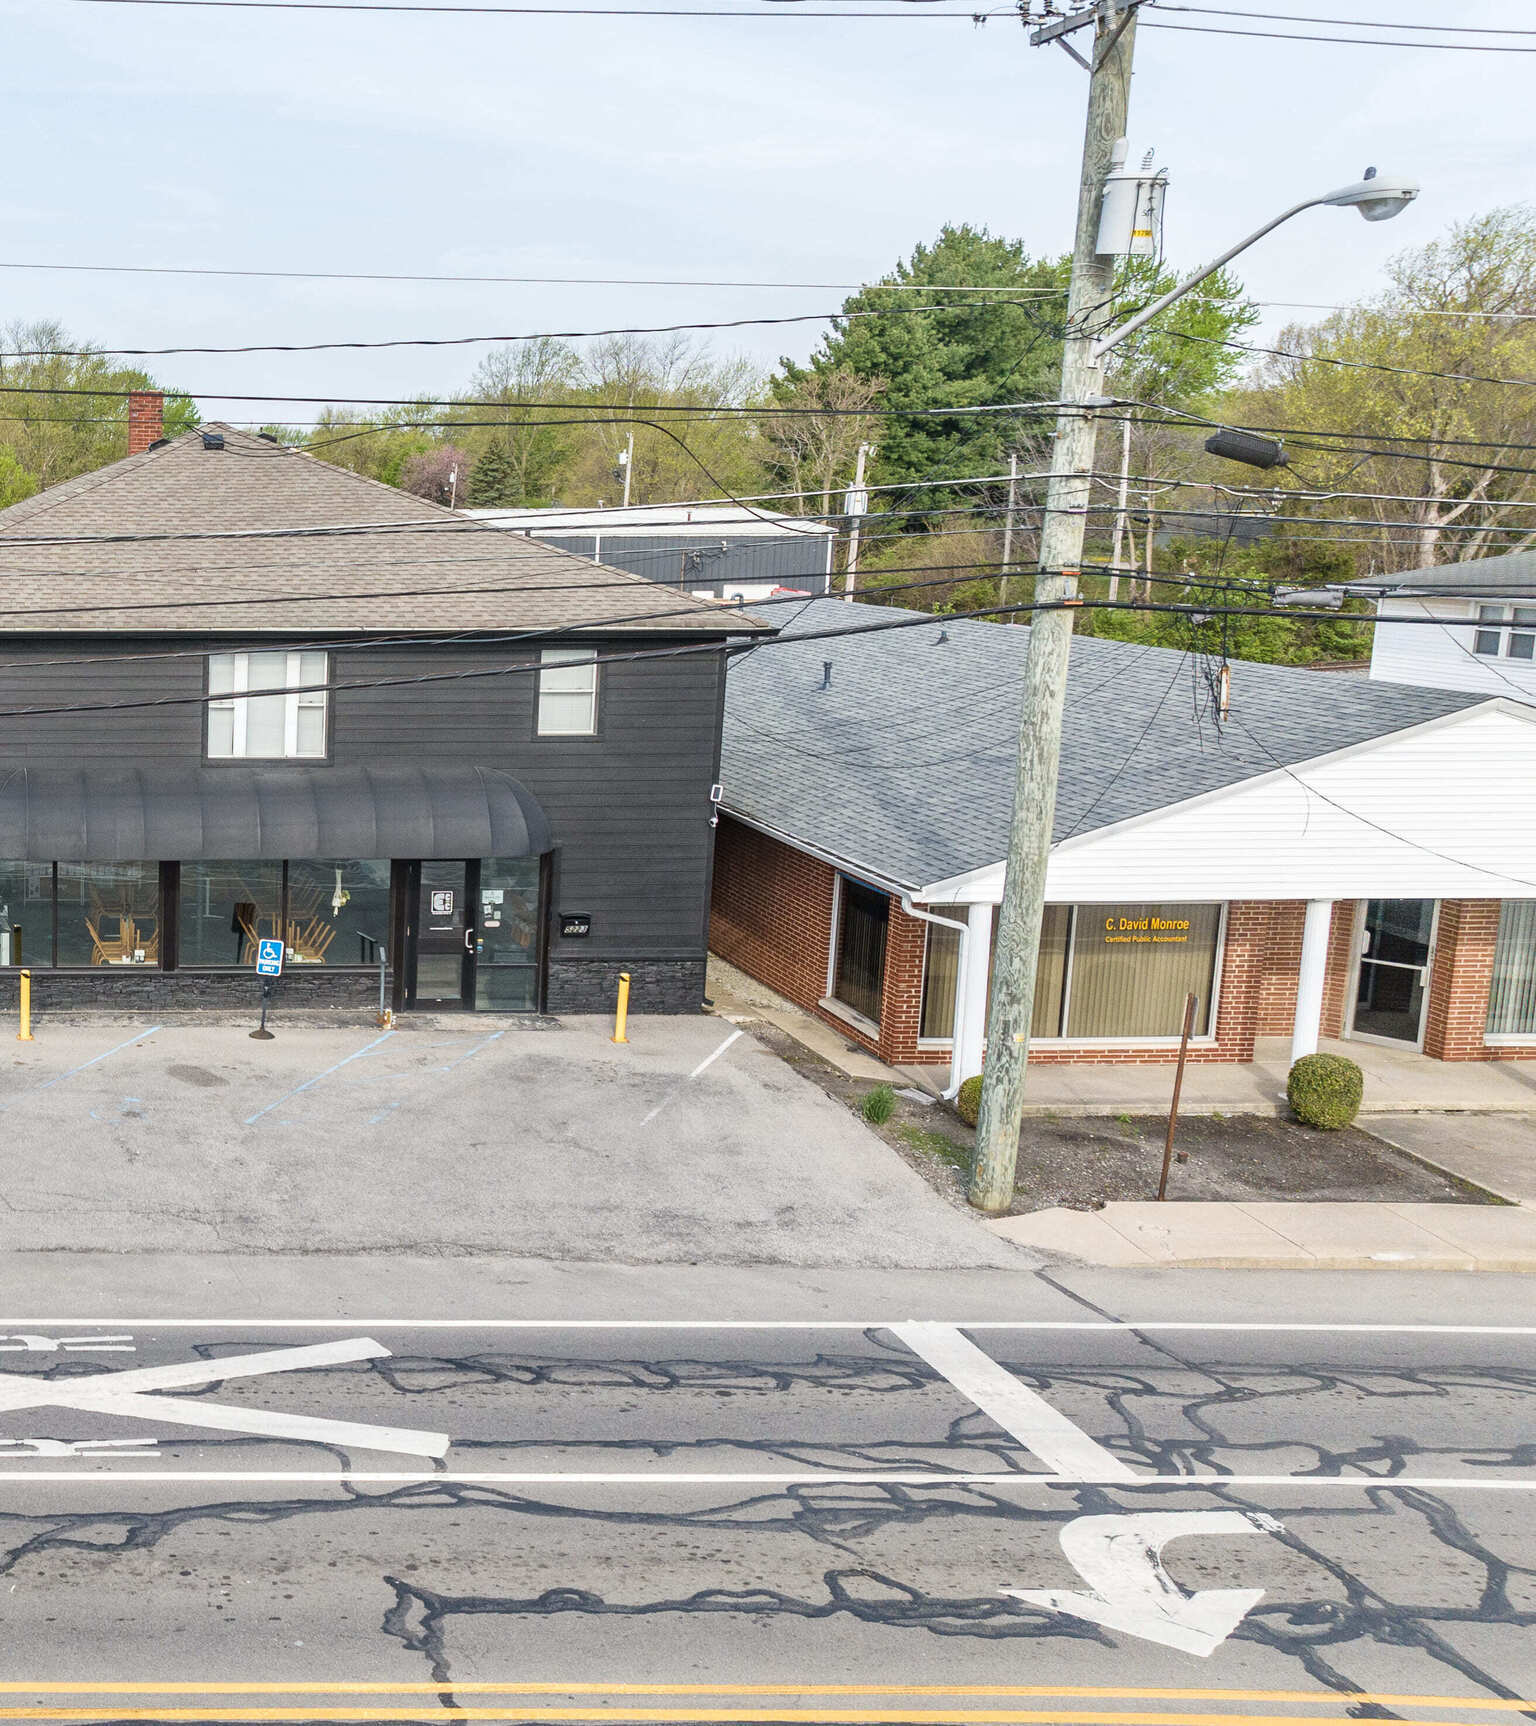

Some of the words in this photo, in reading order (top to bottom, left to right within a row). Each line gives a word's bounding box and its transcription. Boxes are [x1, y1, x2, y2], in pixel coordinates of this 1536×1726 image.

[1105, 918, 1116, 930] C.
[1119, 917, 1149, 930] David
[1151, 917, 1190, 930] Monroe
